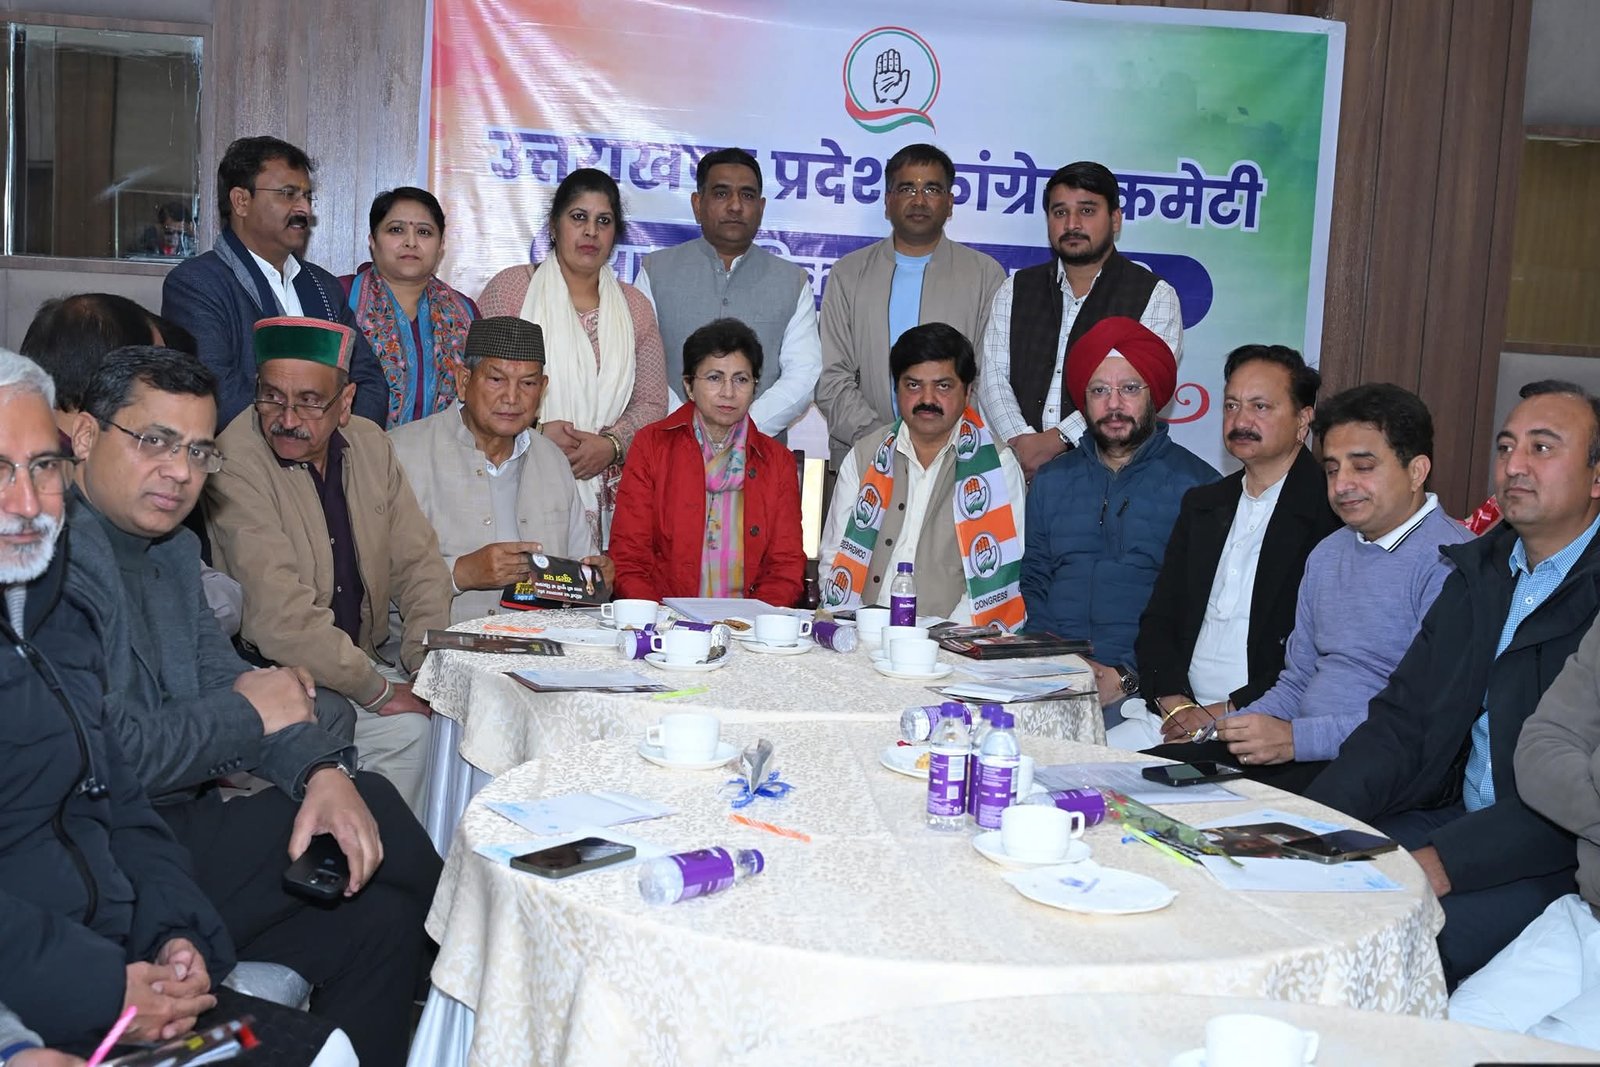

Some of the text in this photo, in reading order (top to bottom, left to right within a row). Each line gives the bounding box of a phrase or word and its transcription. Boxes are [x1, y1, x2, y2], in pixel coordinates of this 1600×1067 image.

[489, 131, 757, 190] उत्तराख
[1112, 162, 1264, 228] कमेटी
[974, 590, 1008, 611] CONGRESS
